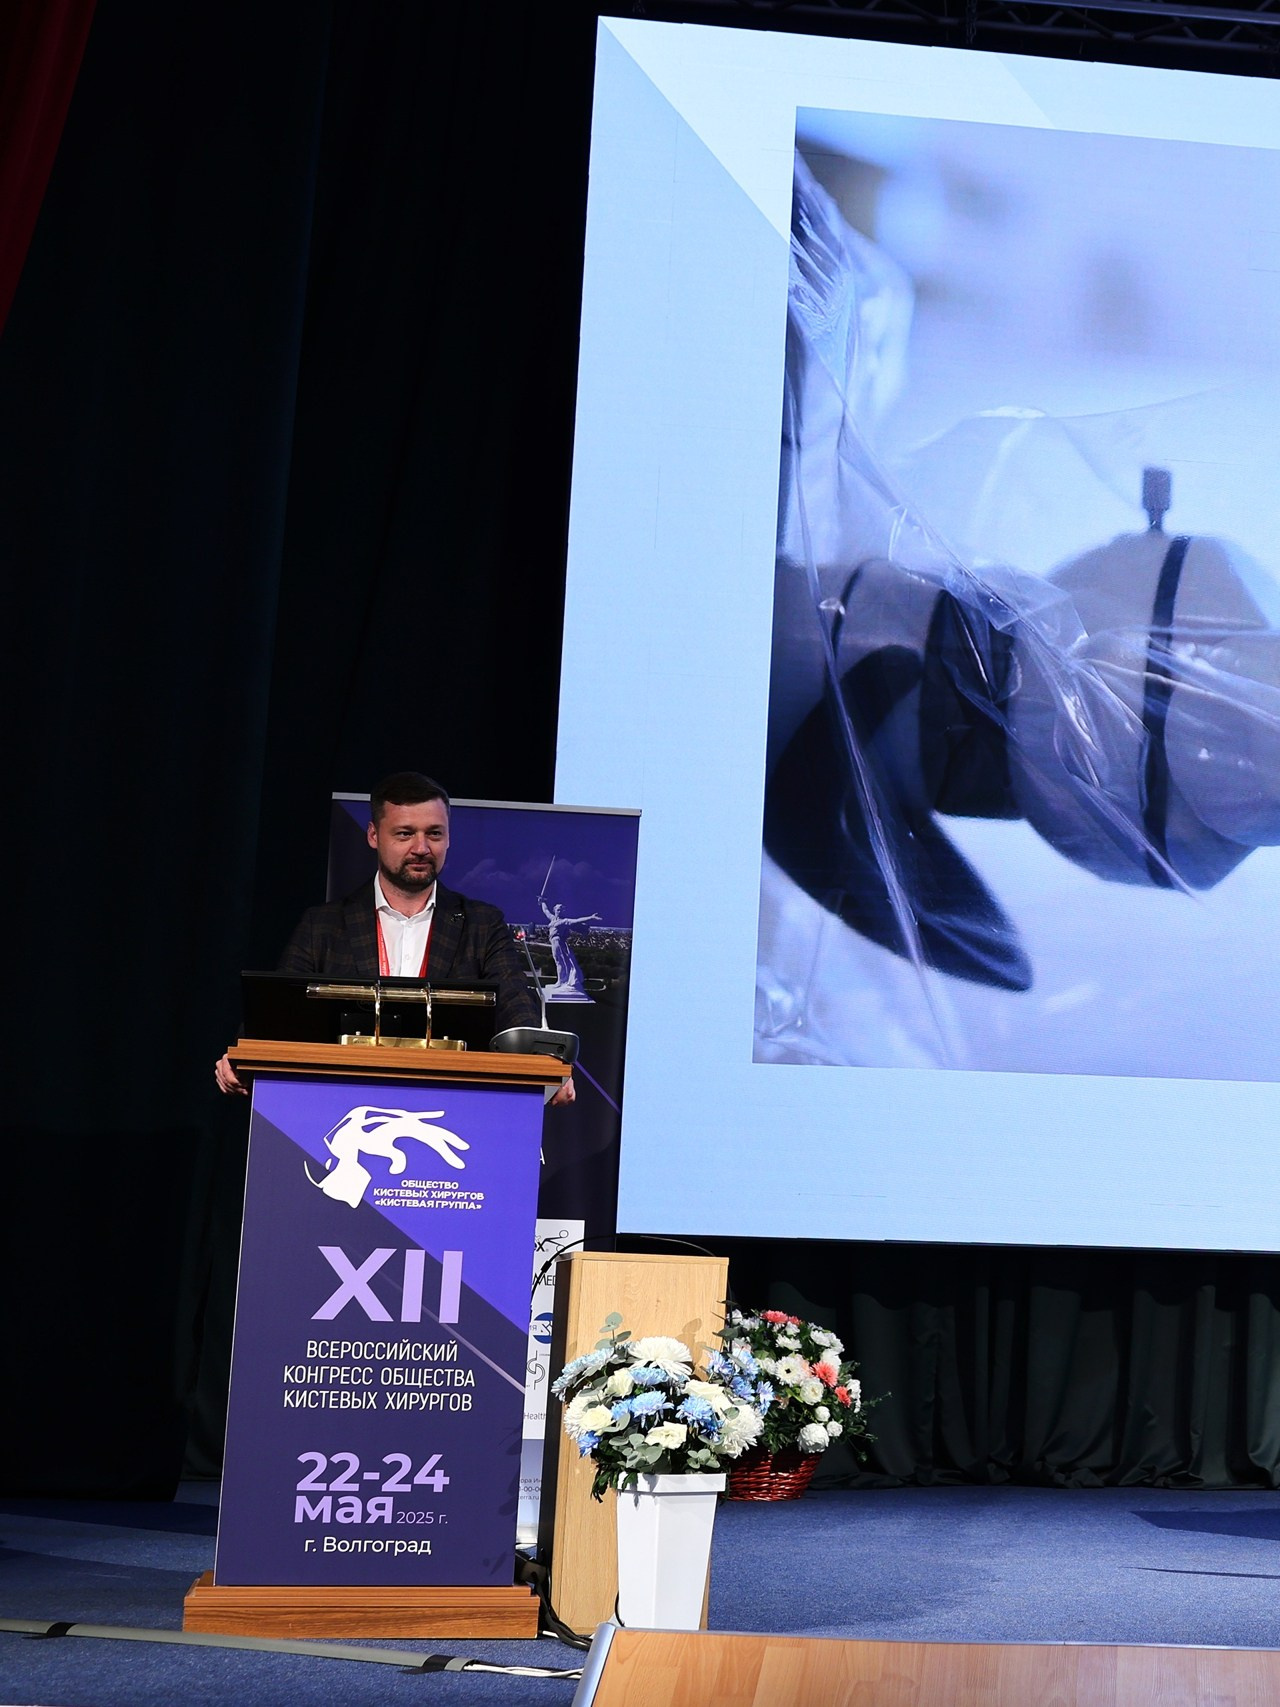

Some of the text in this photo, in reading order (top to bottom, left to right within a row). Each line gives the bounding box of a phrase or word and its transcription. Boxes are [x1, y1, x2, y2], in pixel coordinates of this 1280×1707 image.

[373, 1188, 485, 1200] КИСТЕВЫХ ХИРУРГОВ
[401, 1179, 459, 1190] ОБЩЕСТВО
[374, 1198, 482, 1210] «КИСТЕВАЯ ГРУППА»
[310, 1245, 463, 1324] XII
[306, 1339, 458, 1362] ВСЕРОССИЙСКИЙ
[283, 1365, 475, 1389] КОНГРЕСС ОБЩЕСТВА
[283, 1390, 473, 1412] КИСТЕВЫХ ХИРУРГОВ
[296, 1451, 450, 1493] 22-24
[294, 1495, 448, 1524] мая 2025 г.
[304, 1536, 432, 1556] г. Волгоград
